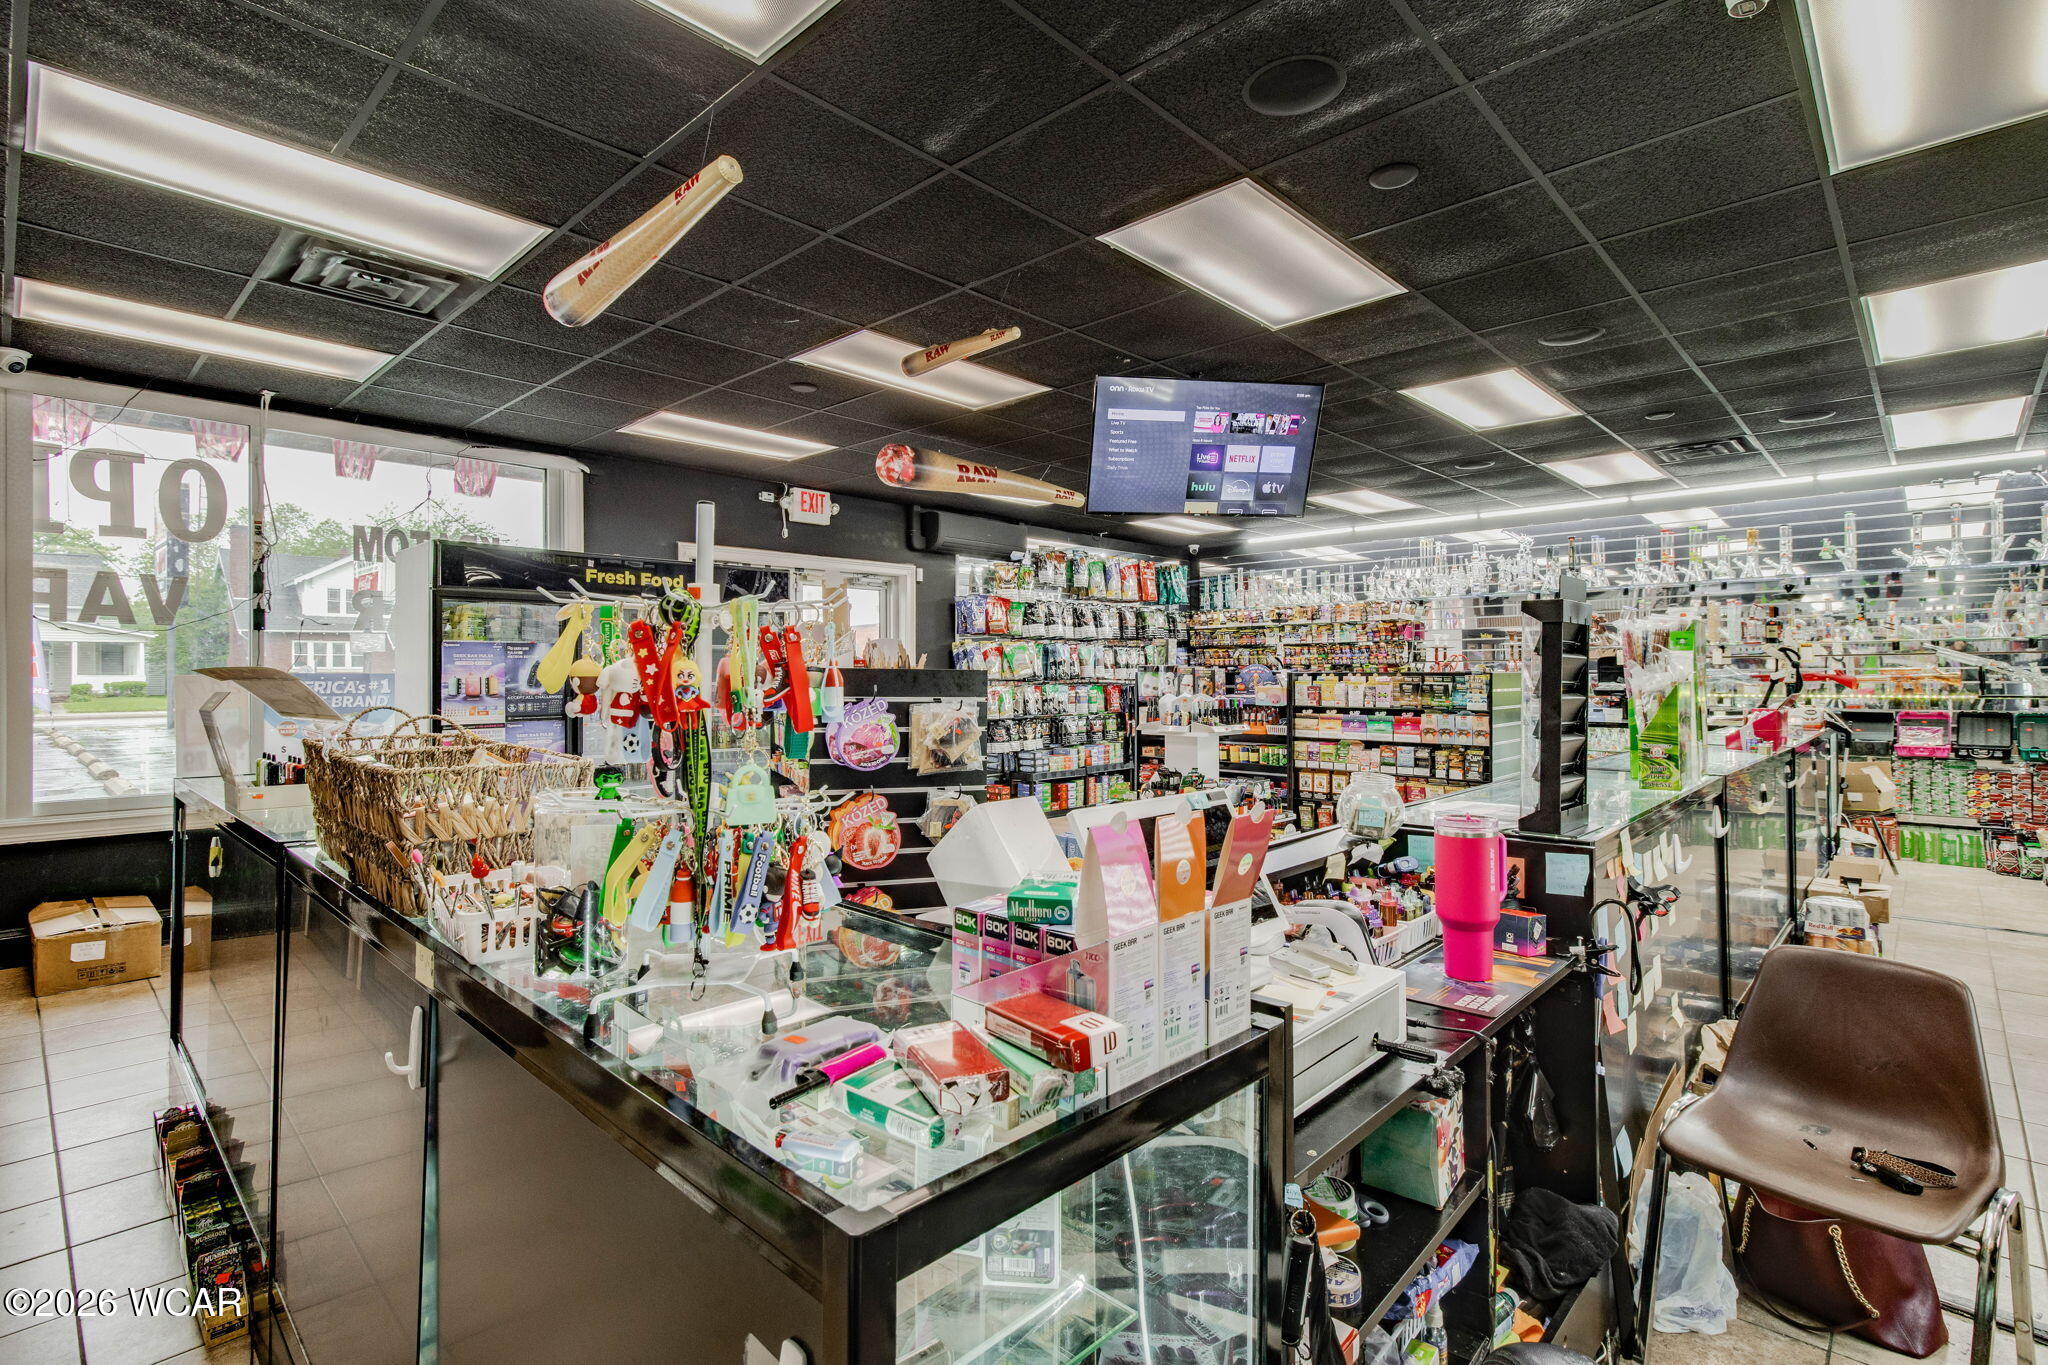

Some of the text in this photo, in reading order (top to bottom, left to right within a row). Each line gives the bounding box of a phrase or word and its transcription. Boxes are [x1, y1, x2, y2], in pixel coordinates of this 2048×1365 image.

[674, 173, 700, 202] RAW
[989, 330, 1006, 342] RAW
[924, 343, 951, 362] RAW
[1228, 455, 1256, 463] NETFLIX
[956, 463, 998, 482] RAW
[1191, 481, 1216, 491] hulu
[800, 491, 826, 514] EXIT
[585, 568, 684, 589] Fresh Food
[306, 678, 391, 694] RICA's #1
[331, 695, 389, 708] BRAND
[843, 700, 887, 728] KÓZED
[842, 797, 888, 827] KÓZED
[750, 853, 767, 898] Football
[790, 869, 802, 901] NIKE
[724, 860, 732, 923] PRIME
[1011, 899, 1052, 918] Marlboro
[1213, 908, 1234, 920] GEEK BAR
[955, 913, 976, 929] 60K
[985, 921, 1008, 936] 60K
[1163, 922, 1186, 935] GEEK BAR
[1015, 928, 1038, 944] 60K
[1047, 937, 1073, 952] 60K
[1113, 937, 1138, 951] GEEK BAR
[1103, 1031, 1117, 1055] LD
[204, 1246, 238, 1265] MUSHROOM
